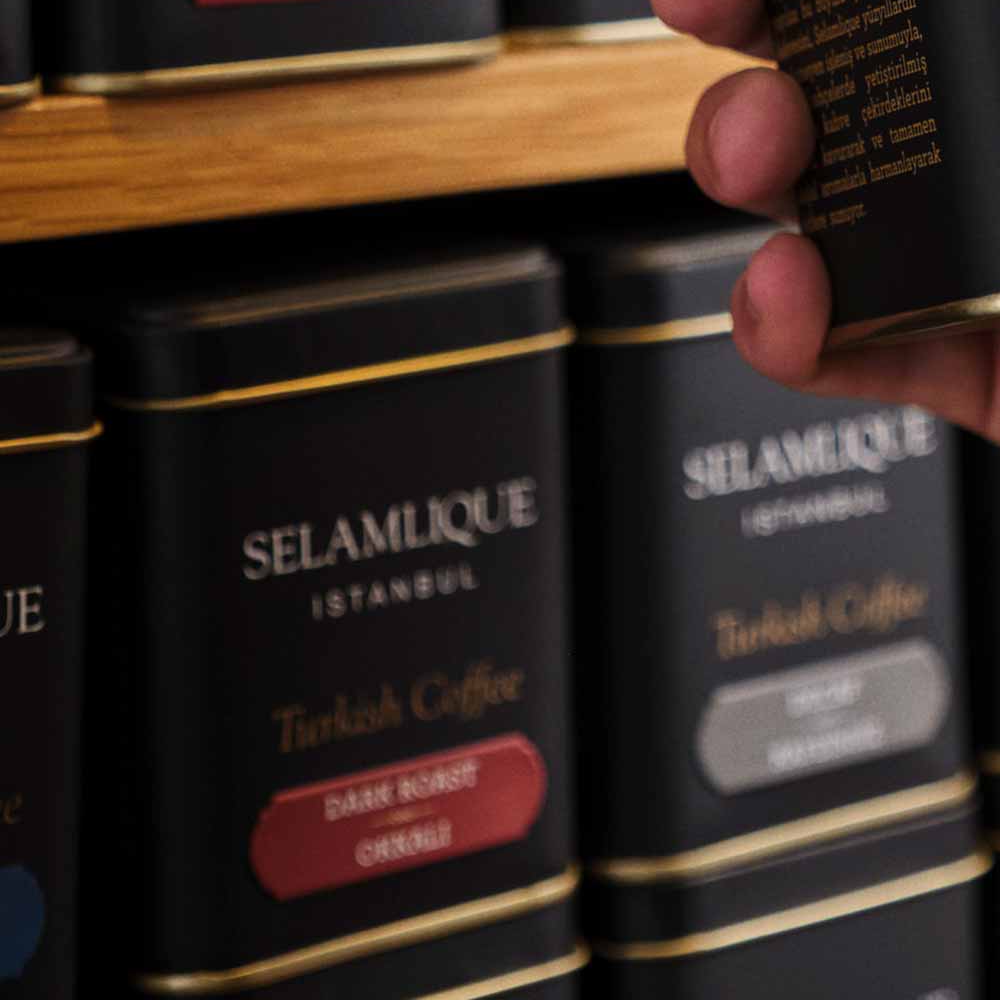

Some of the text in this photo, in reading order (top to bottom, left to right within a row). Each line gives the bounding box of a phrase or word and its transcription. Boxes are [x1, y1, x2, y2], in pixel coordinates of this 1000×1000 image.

[866, 18, 923, 58] sunumuyla,
[864, 52, 928, 95] yetiştirilmiş
[860, 81, 933, 128] çekirdeklerini
[871, 134, 884, 150] ve
[889, 117, 938, 145] tamamen
[868, 140, 943, 182] harmanlayarak
[242, 475, 540, 580] SELAMLIQUE
[312, 562, 480, 621] ISTANBUL
